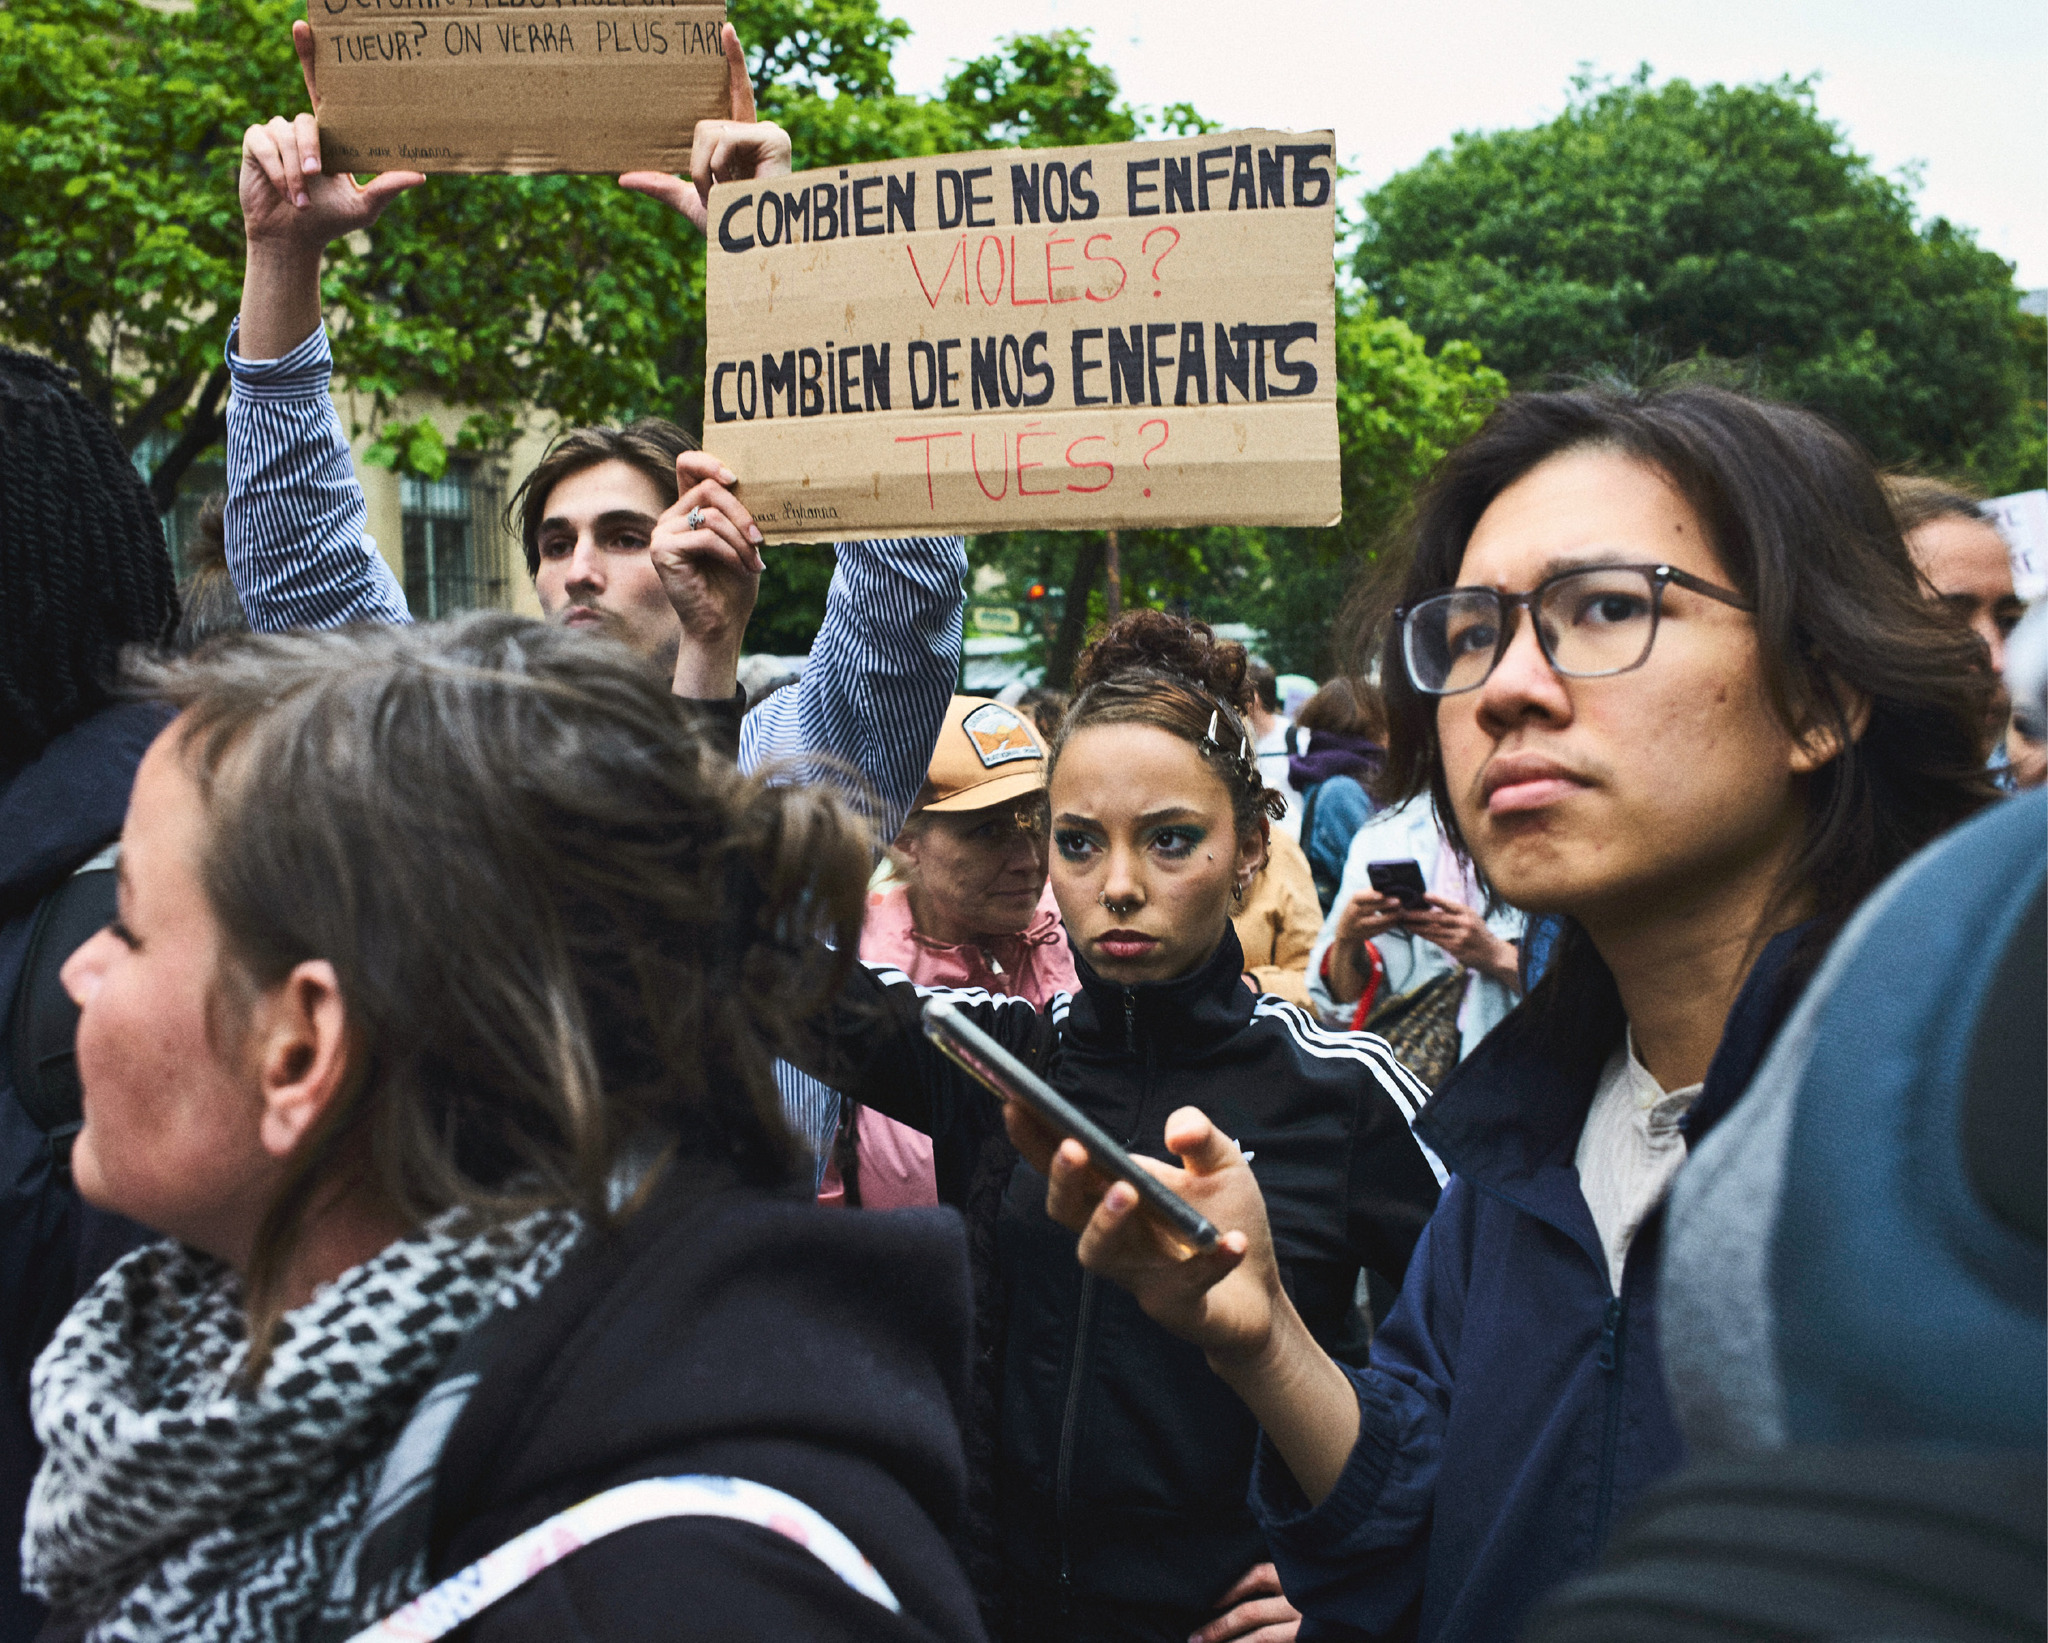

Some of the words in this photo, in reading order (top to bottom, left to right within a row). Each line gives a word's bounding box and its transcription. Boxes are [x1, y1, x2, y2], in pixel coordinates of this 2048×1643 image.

[331, 21, 428, 63] TUEUR?
[444, 21, 482, 56] ON
[496, 22, 574, 53] VERRA
[597, 21, 668, 54] PLUS
[937, 167, 995, 229] DE
[1011, 160, 1099, 224] NOS
[1127, 144, 1332, 216] ENFANTS
[1071, 322, 1318, 406] ENFANTS
